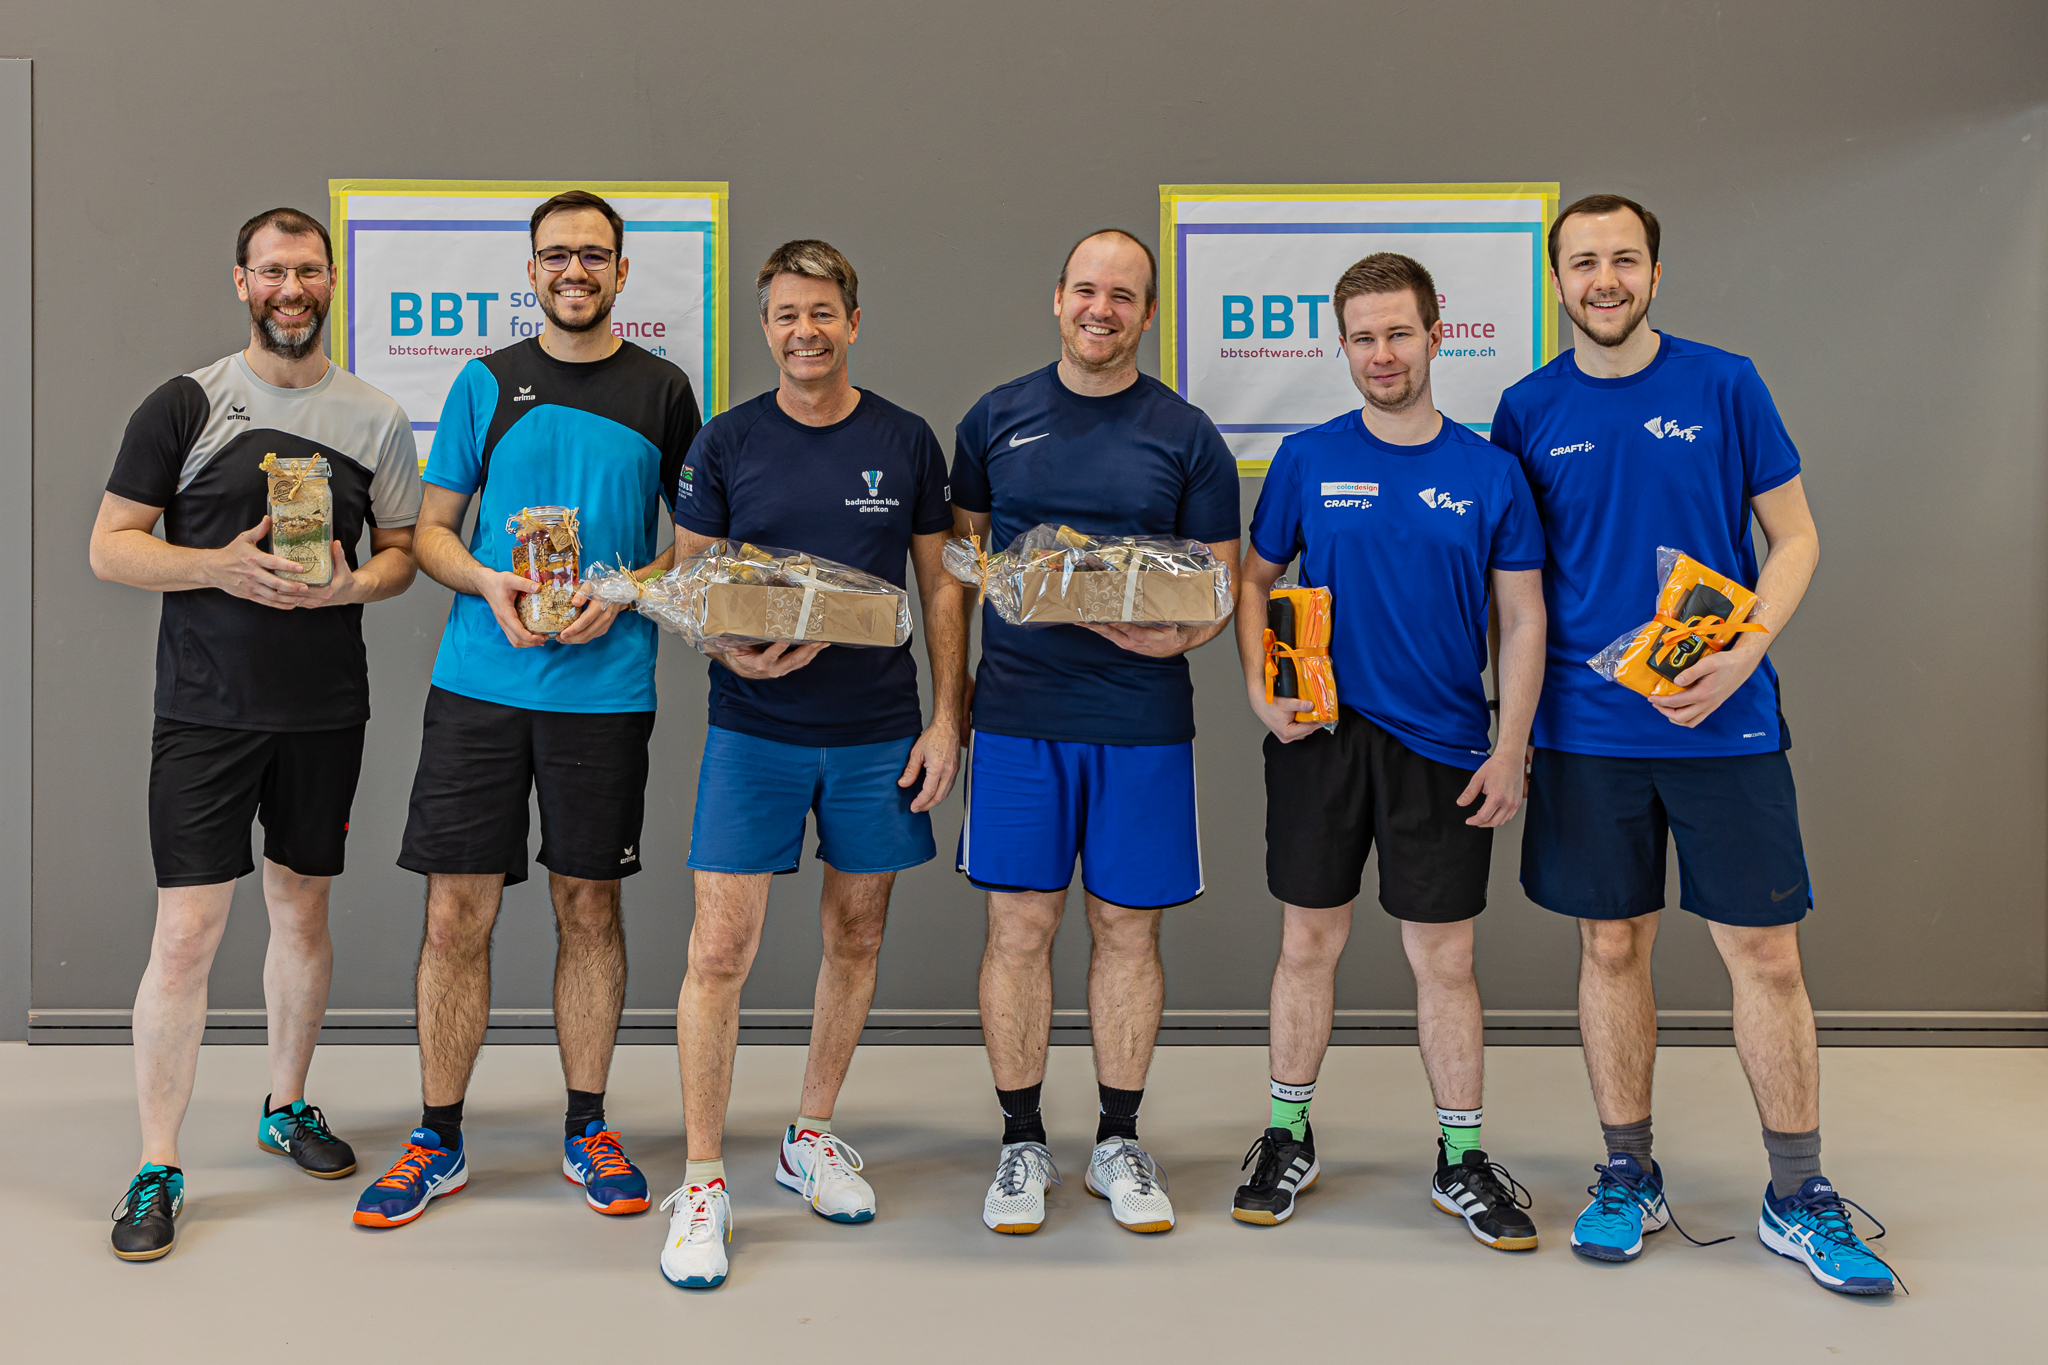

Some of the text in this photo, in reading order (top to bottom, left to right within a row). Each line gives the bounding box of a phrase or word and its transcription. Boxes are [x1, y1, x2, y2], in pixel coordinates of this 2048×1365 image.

[391, 292, 498, 337] BBT
[1222, 294, 1329, 340] BBT
[510, 316, 666, 338] for ance
[389, 345, 492, 356] bbtsoftware.ch
[1220, 347, 1323, 358] bbtsoftware.ch
[513, 394, 536, 402] erima
[227, 413, 251, 421] erima
[1550, 443, 1584, 457] CRAFT
[845, 498, 900, 506] badminton klub
[1324, 499, 1361, 508] CRAFT
[859, 505, 889, 513] dierikon
[268, 1125, 291, 1153] FILA
